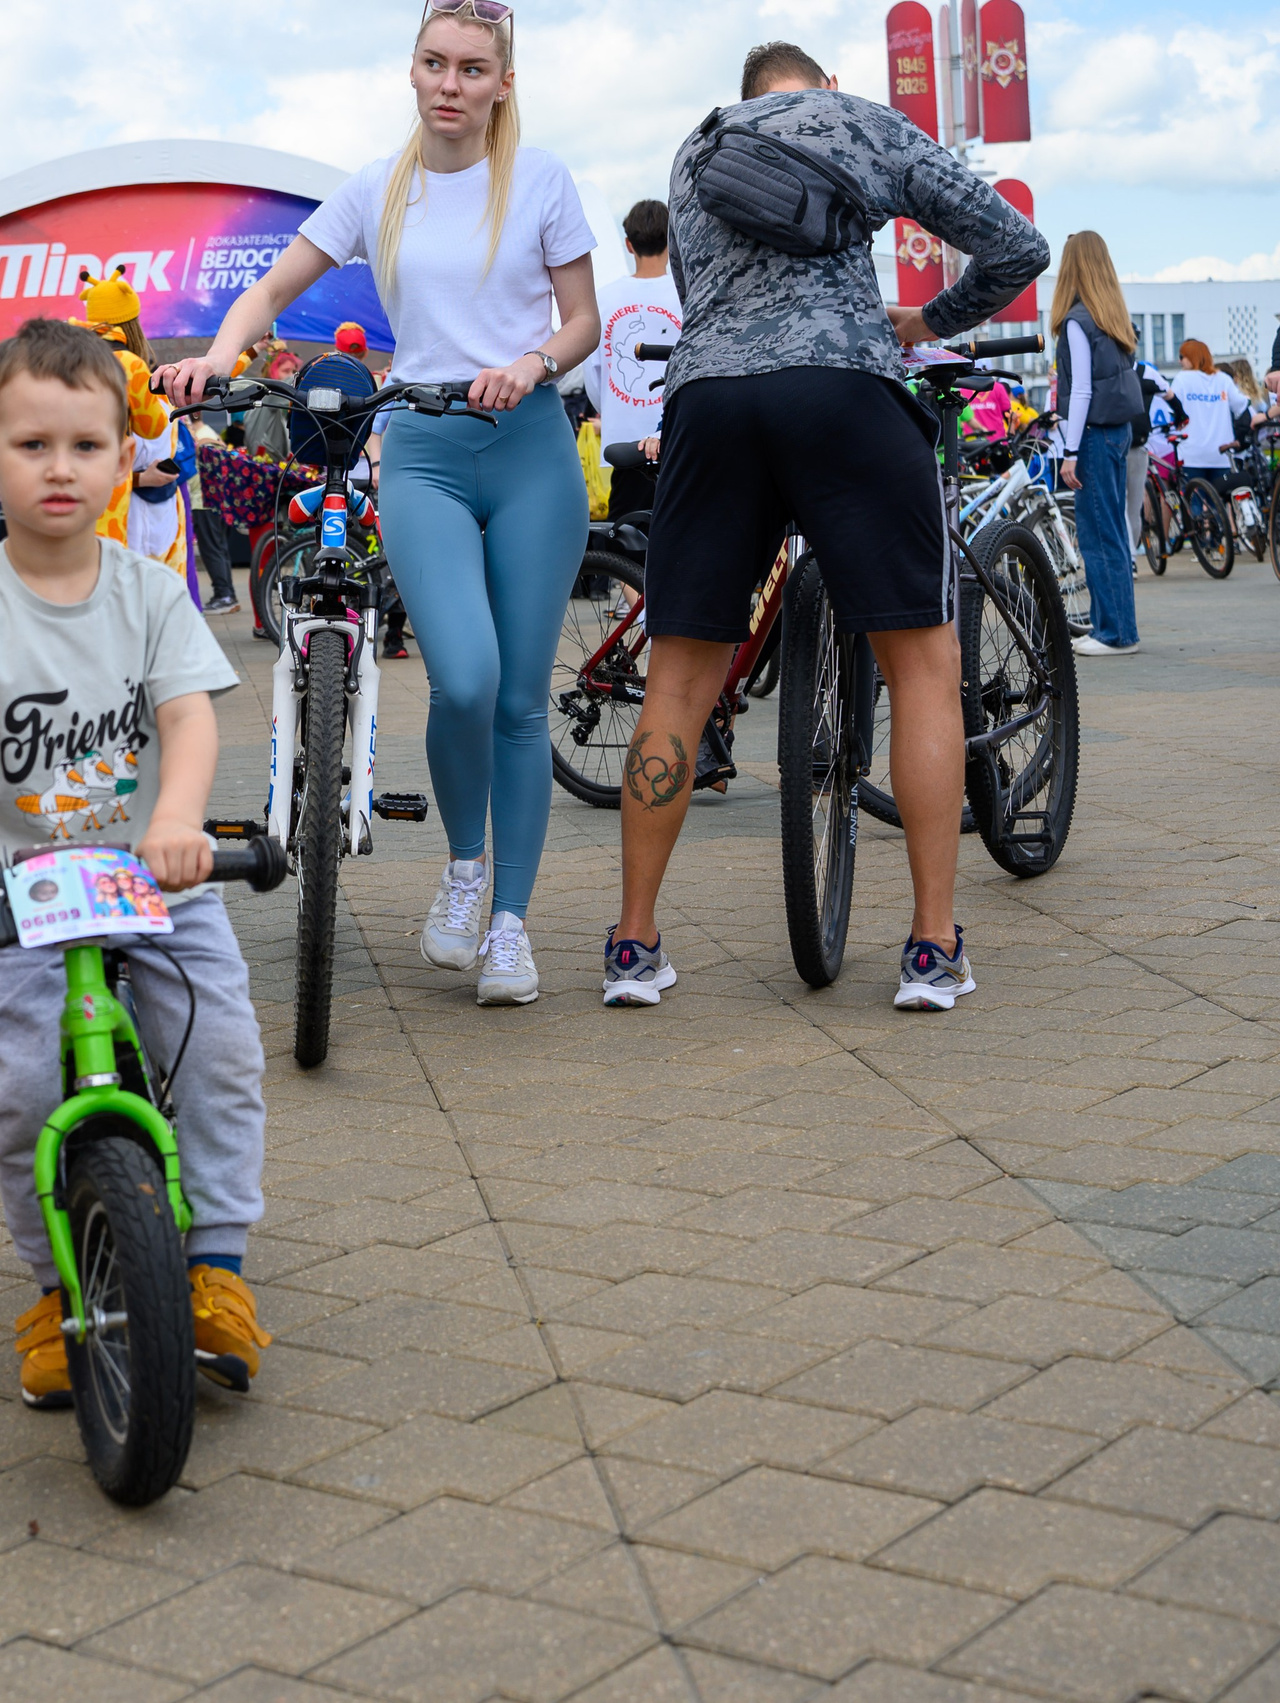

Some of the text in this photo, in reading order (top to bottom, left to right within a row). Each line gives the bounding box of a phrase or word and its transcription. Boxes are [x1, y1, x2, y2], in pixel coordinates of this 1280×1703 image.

[896, 56, 927, 74] 1945
[896, 77, 928, 95] 2025
[201, 248, 288, 269] ВЕЛОСИ
[196, 269, 258, 290] КЛУБ
[749, 536, 788, 636] WELT
[21, 907, 82, 930] 06899
